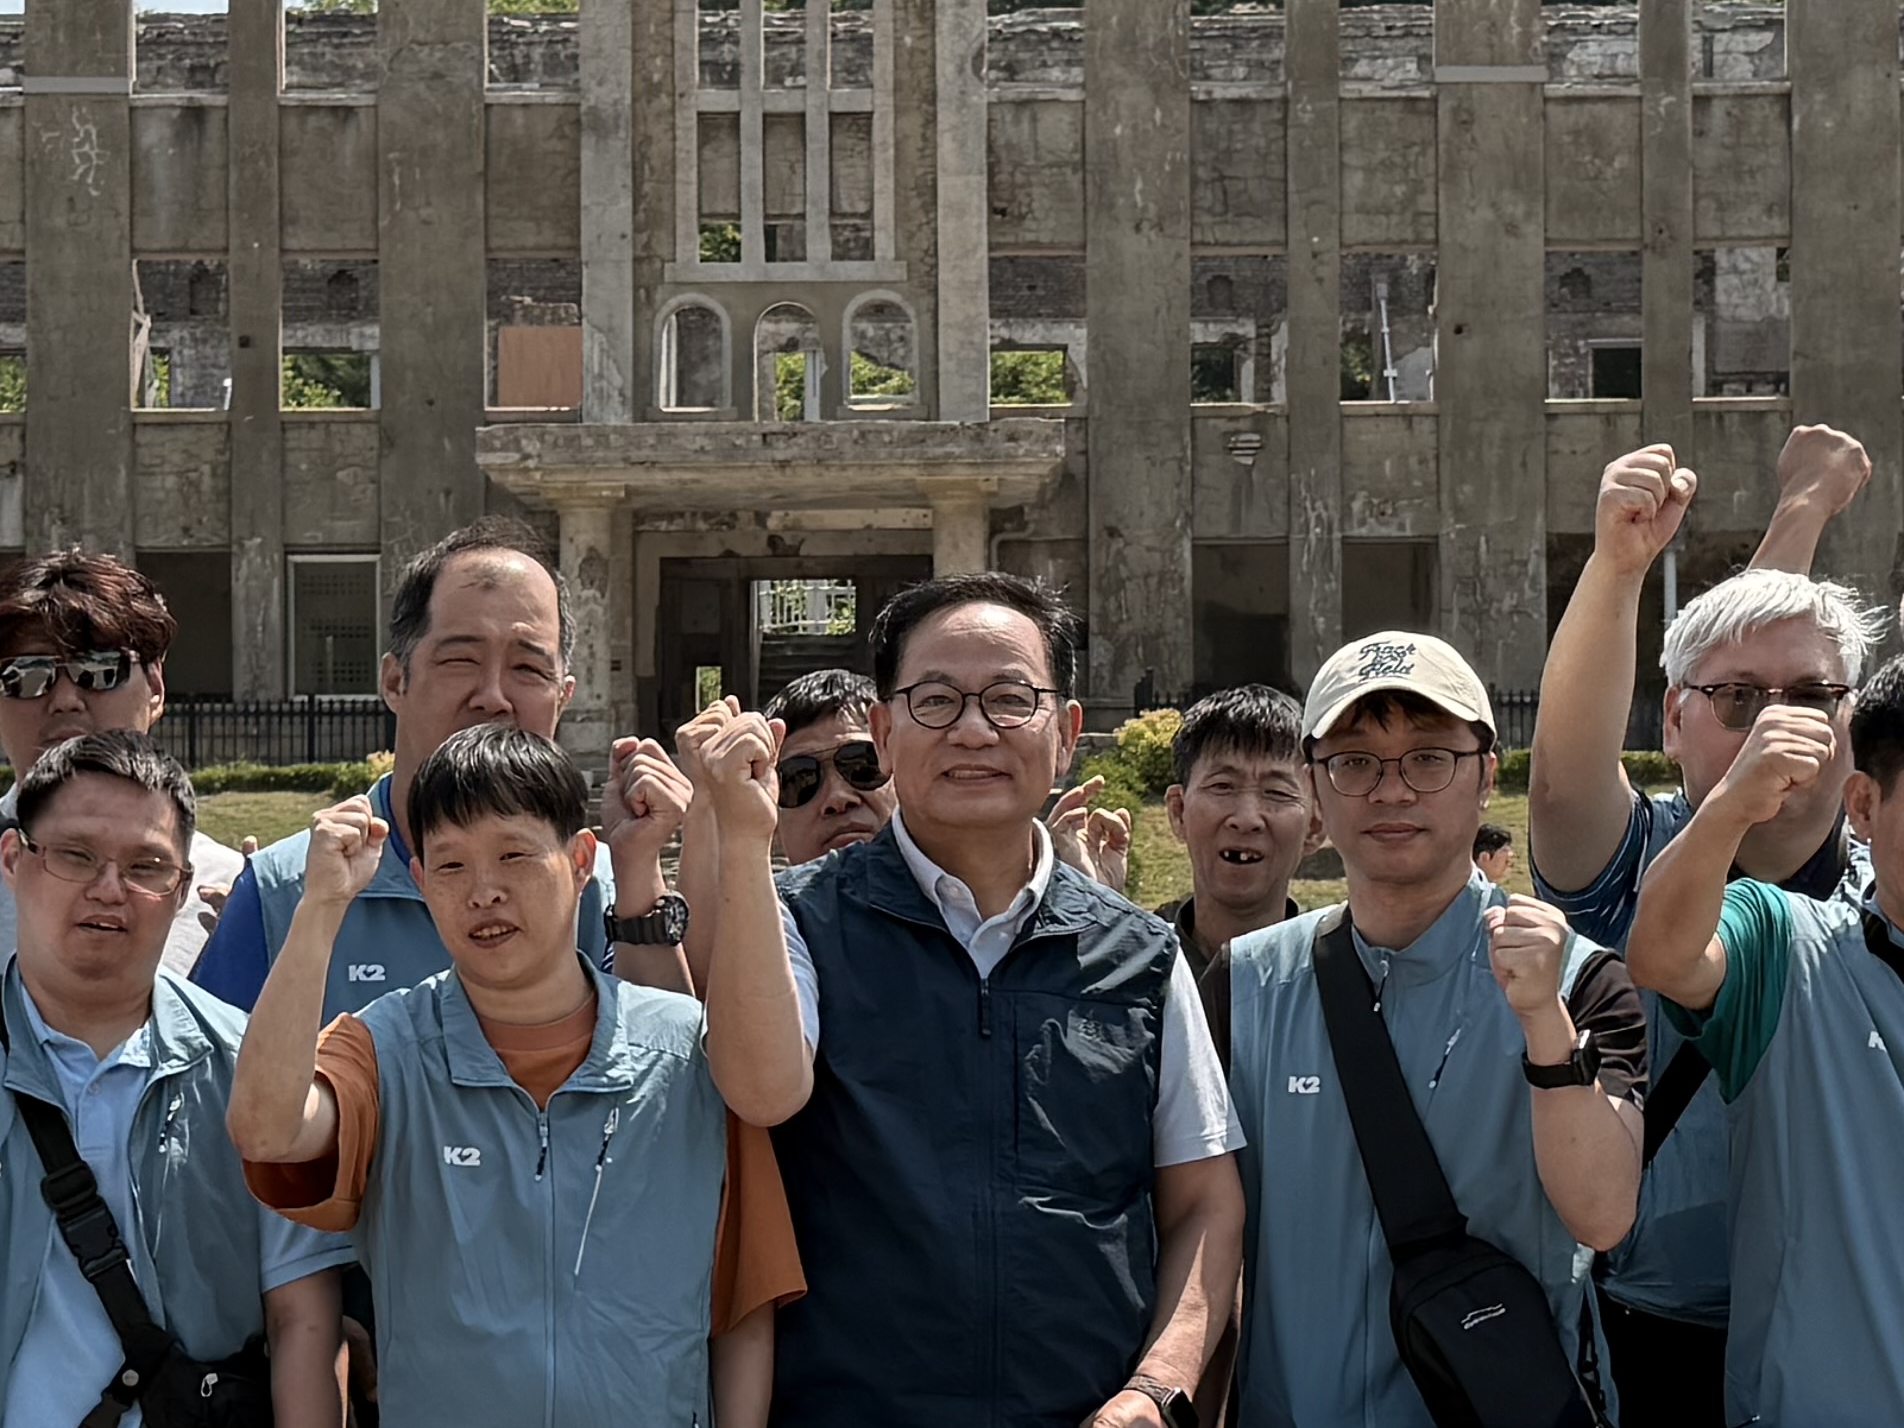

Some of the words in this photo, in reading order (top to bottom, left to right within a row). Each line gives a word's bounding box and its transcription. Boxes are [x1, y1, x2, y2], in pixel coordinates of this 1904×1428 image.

[348, 964, 386, 981] K2
[1288, 1075, 1321, 1093] K2
[443, 1146, 481, 1166] K2
